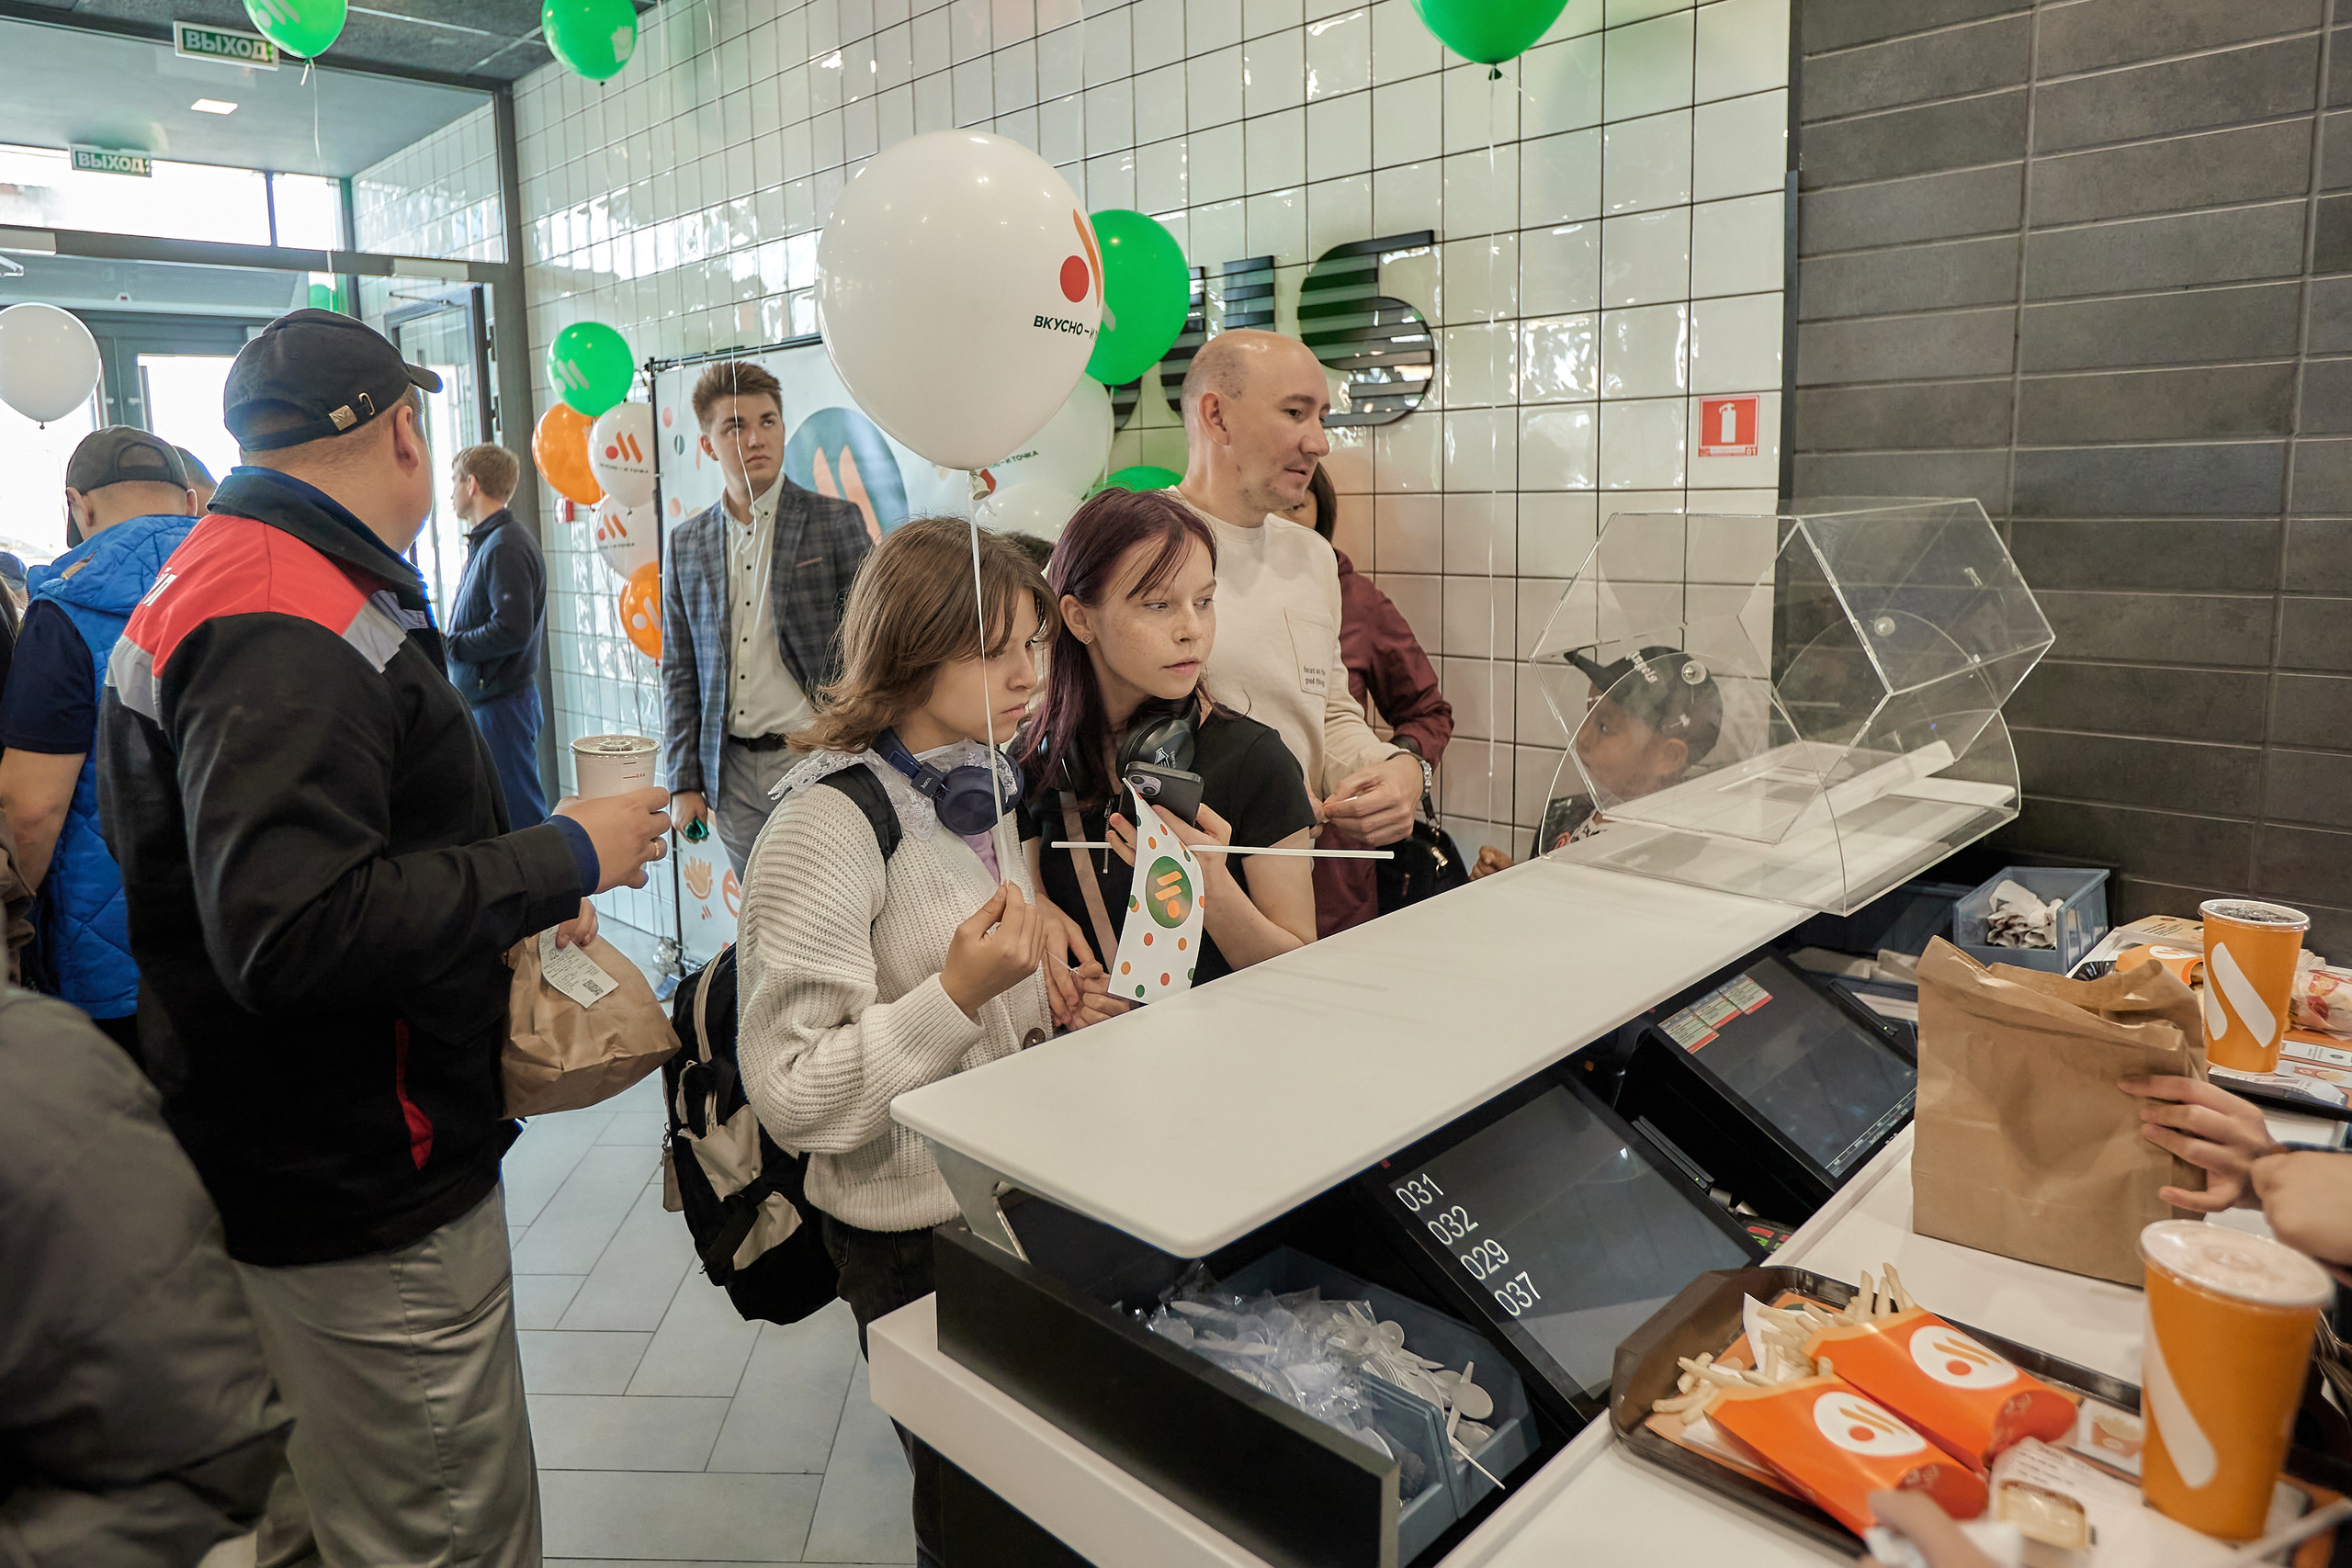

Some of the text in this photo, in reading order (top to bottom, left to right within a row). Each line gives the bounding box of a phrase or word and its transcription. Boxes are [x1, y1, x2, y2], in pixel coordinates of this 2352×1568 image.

[186, 29, 268, 62] ВЫХОД
[77, 152, 145, 174] ВЫХОД
[1033, 315, 1084, 335] ВКУСНО
[1396, 1173, 1444, 1212] 031
[1427, 1205, 1479, 1246] 032
[1460, 1238, 1510, 1280] 029
[1494, 1270, 1541, 1316] 037
